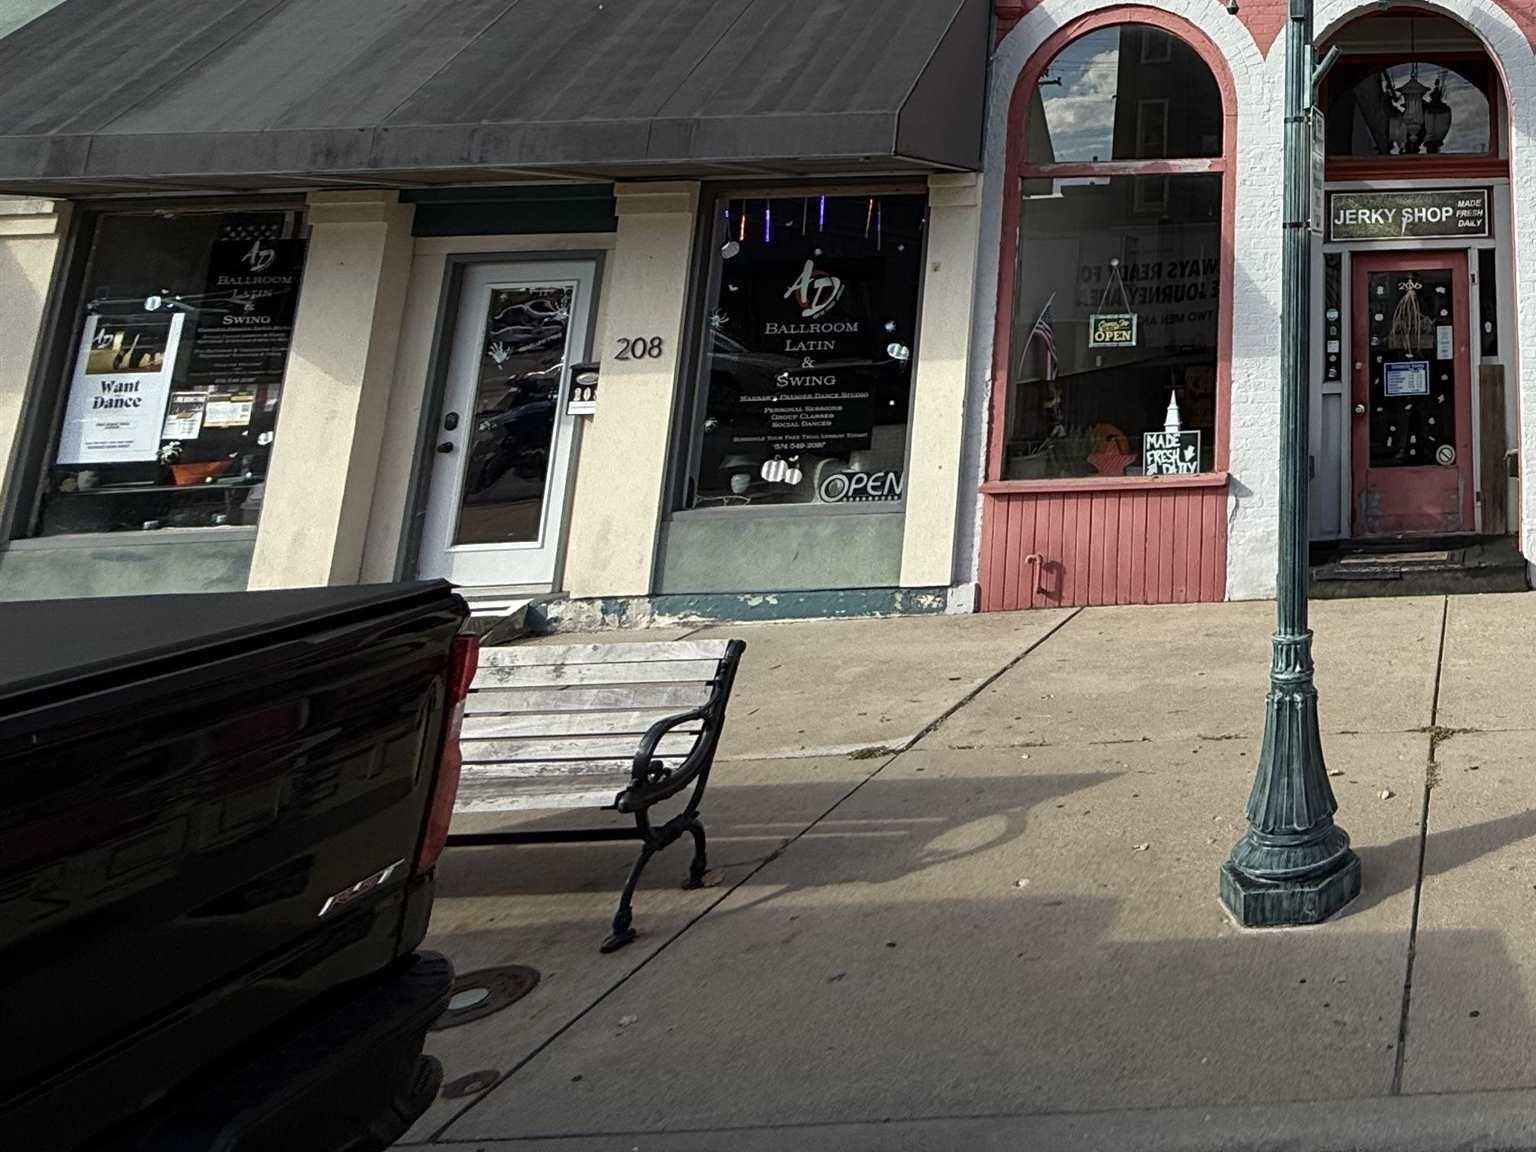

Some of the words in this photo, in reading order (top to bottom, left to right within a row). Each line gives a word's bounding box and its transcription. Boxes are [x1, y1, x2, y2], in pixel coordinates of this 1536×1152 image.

[1457, 200, 1482, 208] MADE
[1334, 209, 1397, 225] JERKY
[1401, 206, 1454, 224] SHOP
[1456, 209, 1483, 218] FRESH
[1457, 219, 1482, 228] DAILY
[222, 314, 271, 326] SWING
[764, 322, 859, 335] BALLROOM
[1094, 330, 1131, 342] OPEN
[614, 336, 663, 361] 208
[784, 340, 836, 352] LATIN
[801, 356, 816, 369] &
[101, 380, 140, 394] Want
[776, 373, 837, 388] SWING
[92, 395, 143, 410] Dance
[1146, 433, 1181, 449] MADE
[1146, 448, 1181, 466] FRESH
[820, 471, 904, 503] OPEN
